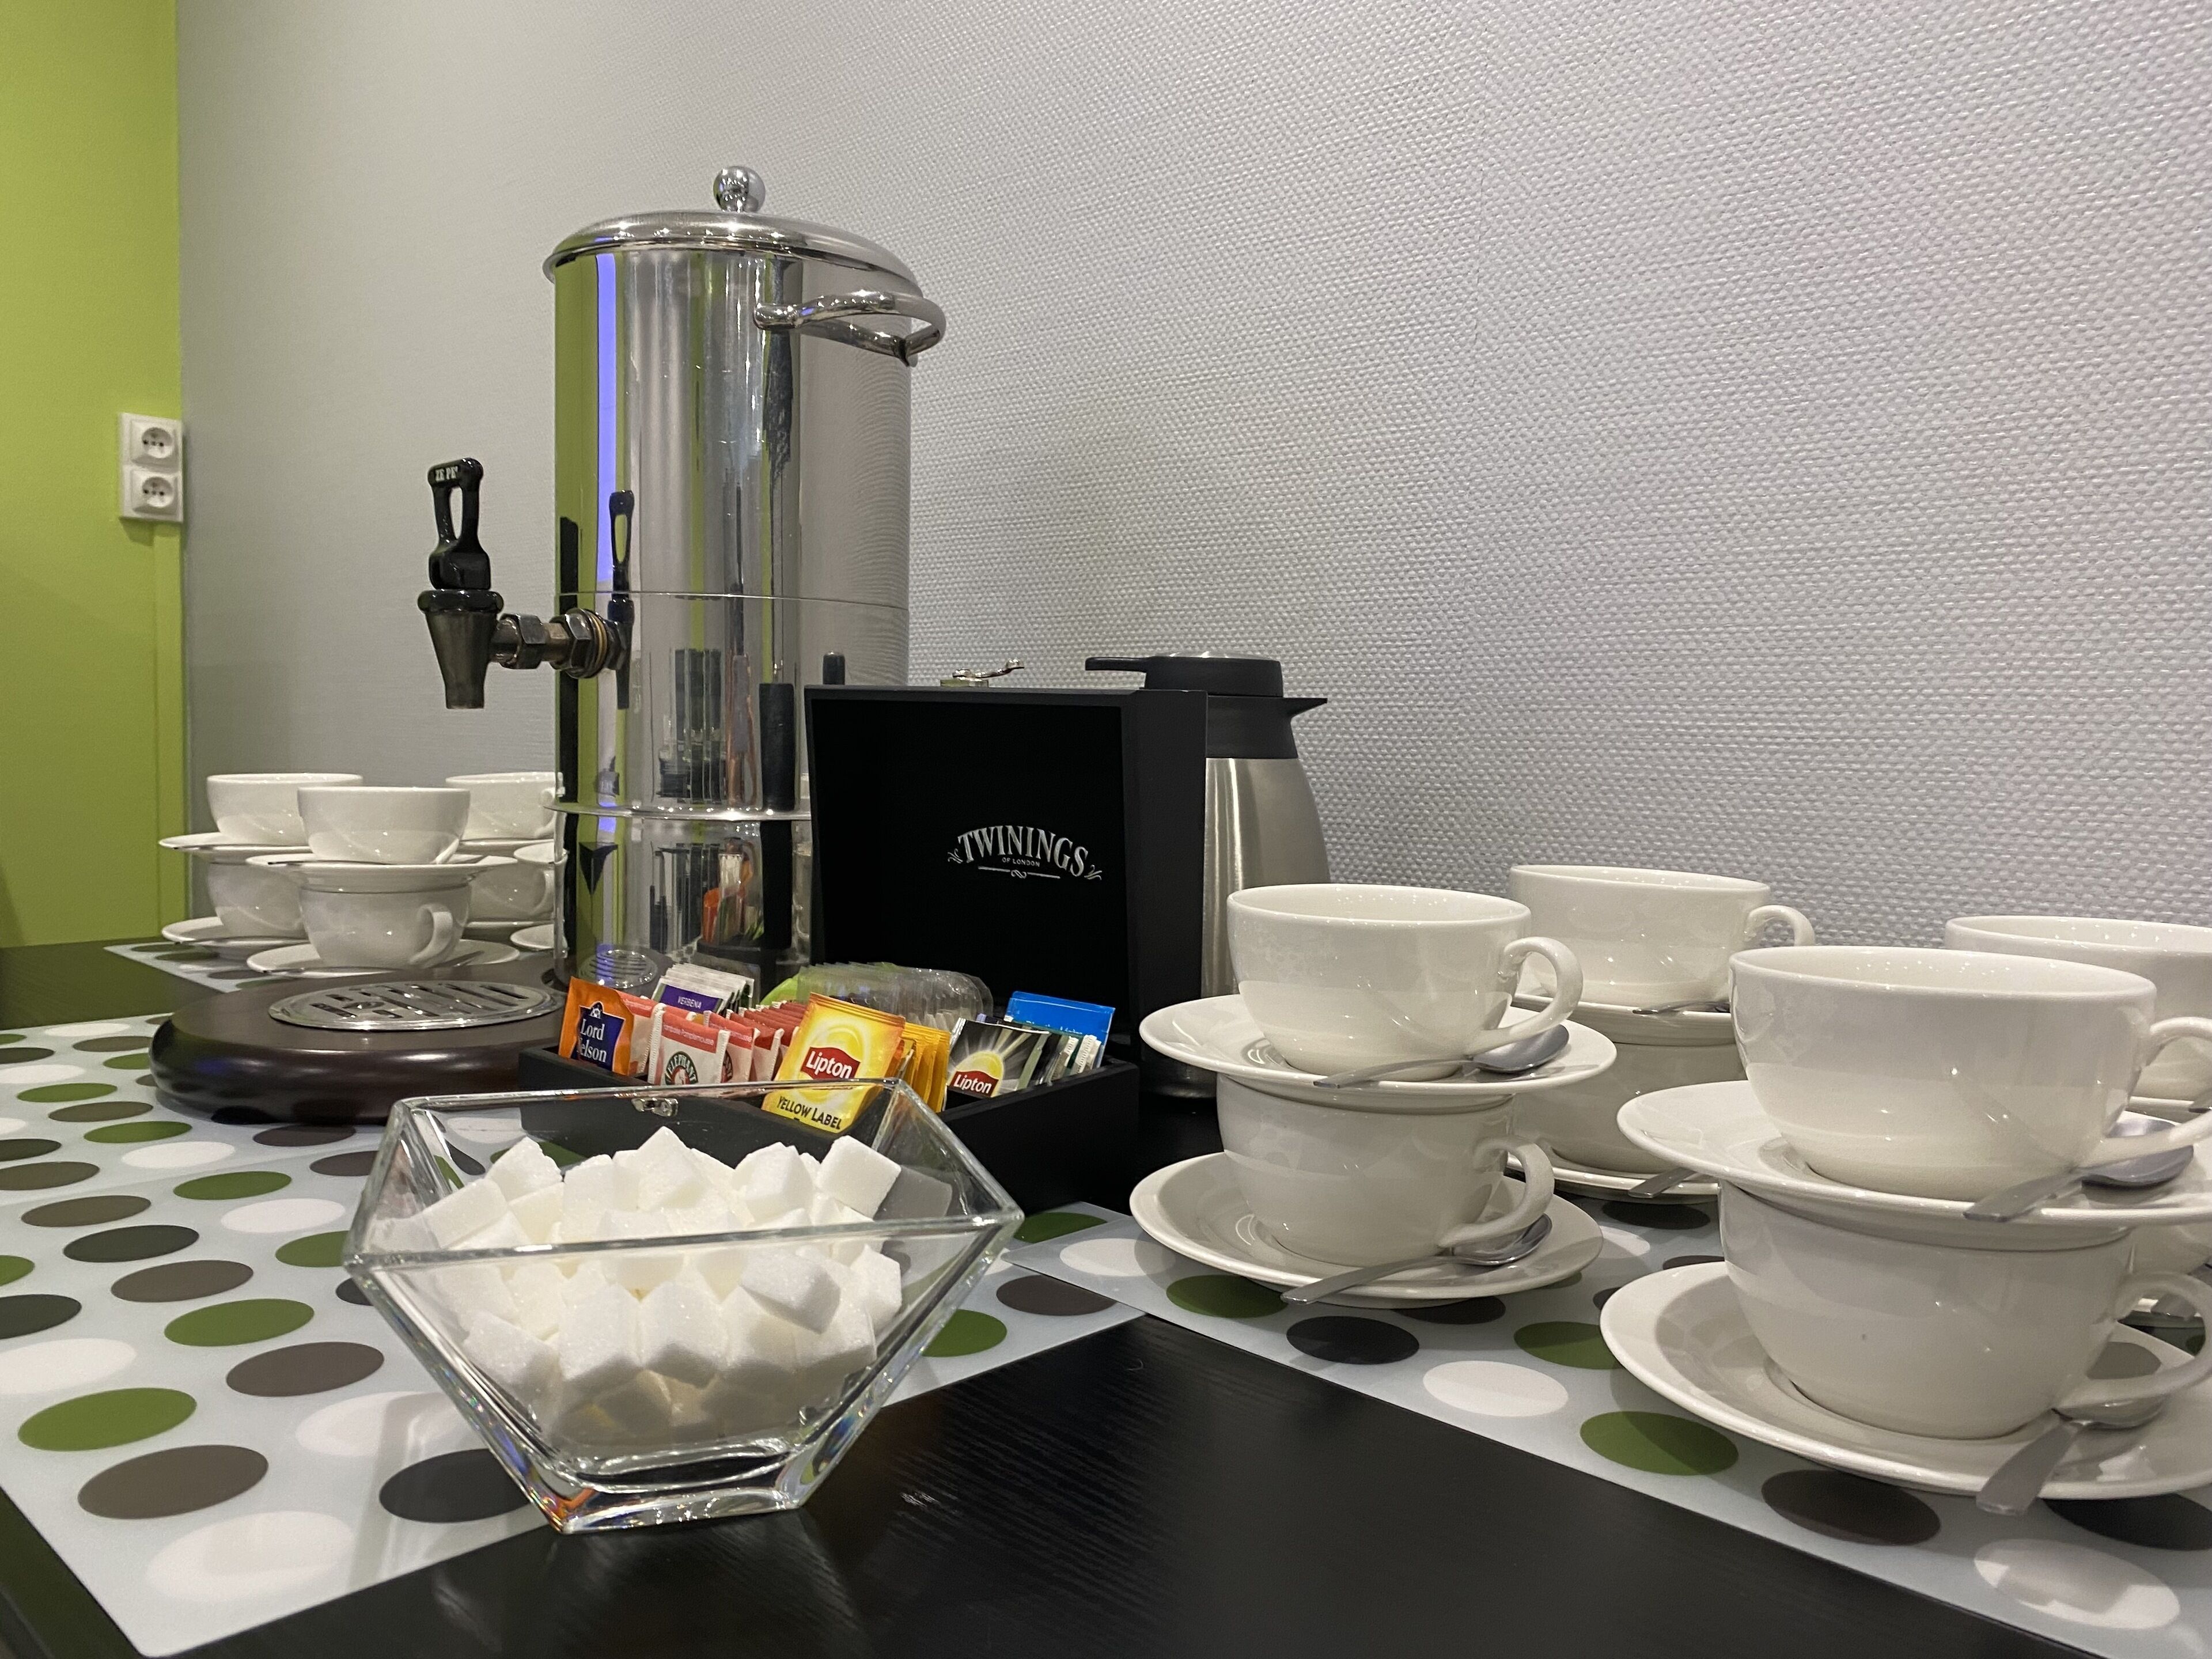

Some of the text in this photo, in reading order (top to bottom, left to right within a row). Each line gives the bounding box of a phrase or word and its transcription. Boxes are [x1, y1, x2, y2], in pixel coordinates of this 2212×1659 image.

[957, 825, 1089, 877] TWININGS
[1012, 858, 1040, 867] LONDON
[677, 996, 702, 1009] VERBENA
[580, 1018, 605, 1041] Lord
[805, 1051, 853, 1079] Lipton
[953, 1074, 993, 1094] Lipton
[777, 1096, 842, 1130] YELLOW LABEL
